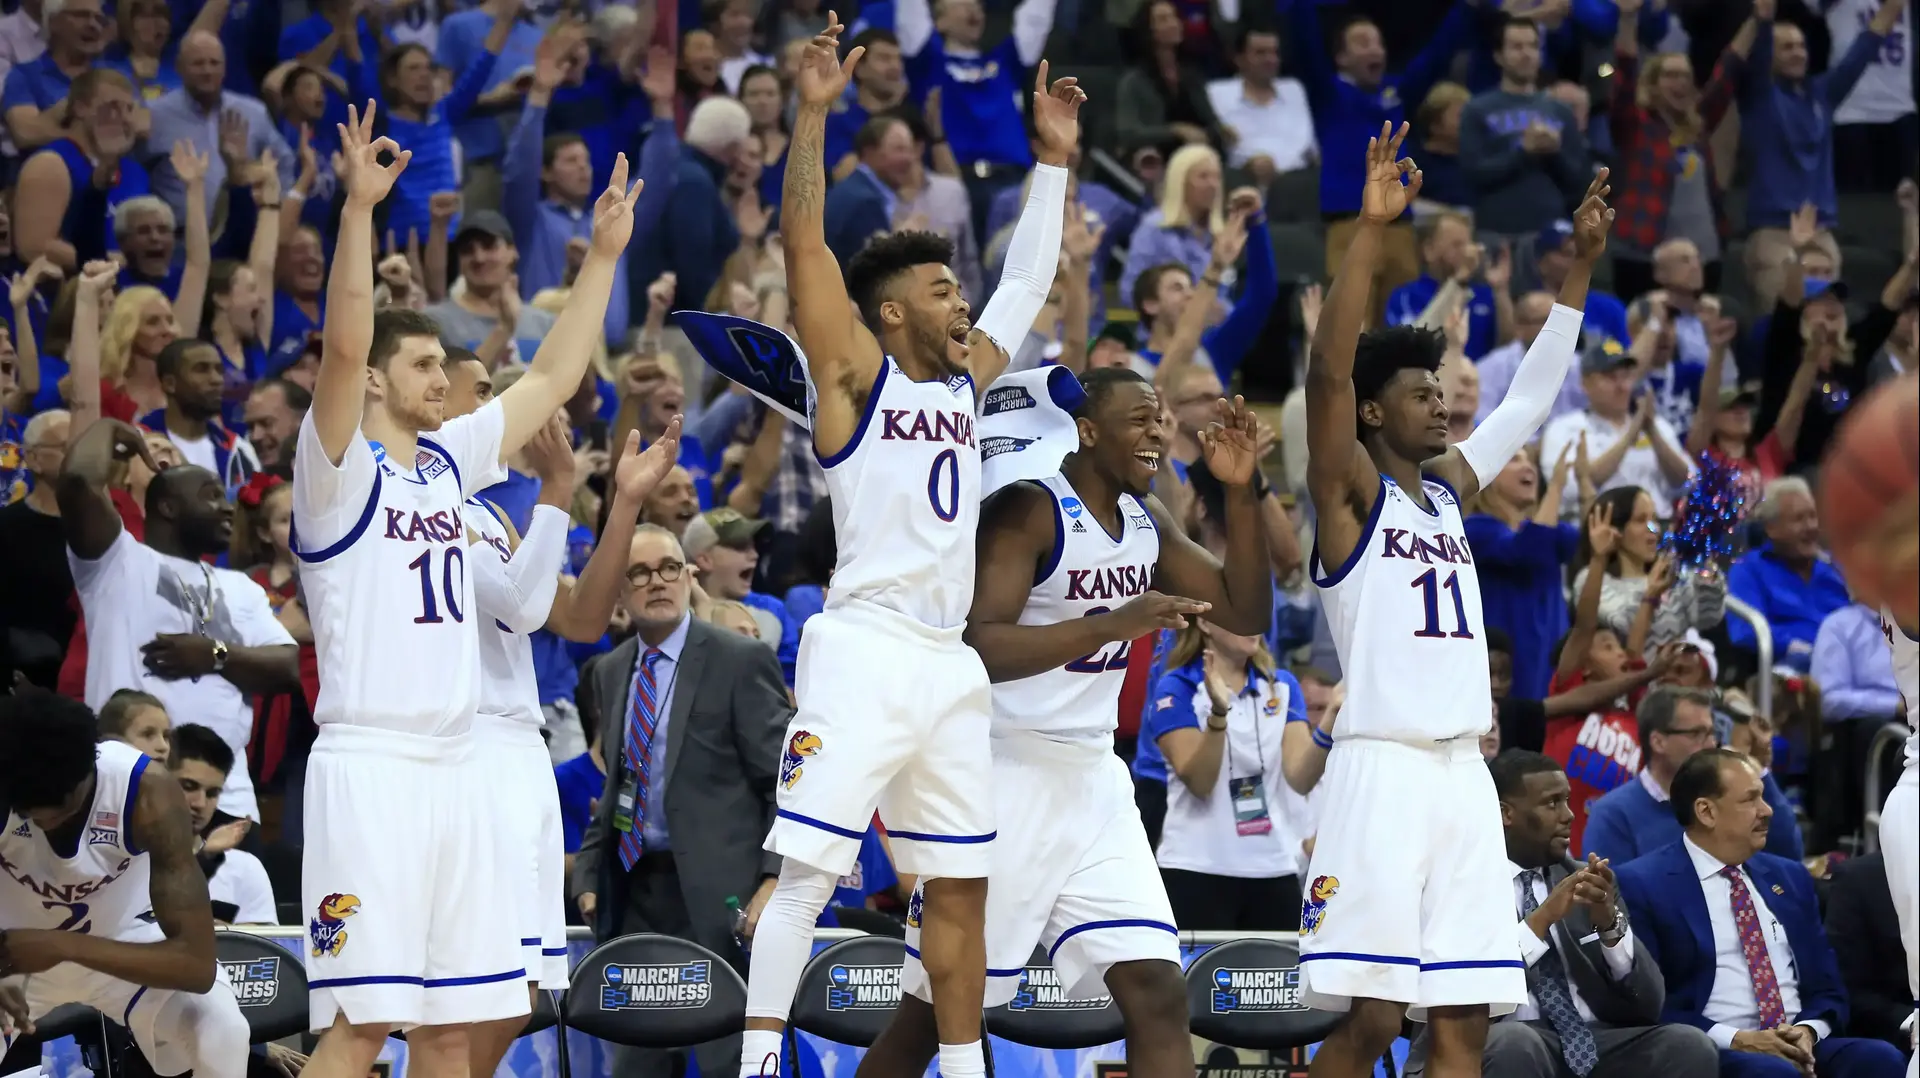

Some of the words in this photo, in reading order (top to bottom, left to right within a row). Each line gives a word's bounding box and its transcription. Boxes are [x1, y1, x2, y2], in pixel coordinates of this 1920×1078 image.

[986, 388, 1022, 405] MADNESS
[999, 397, 1027, 411] MARCH
[881, 409, 976, 450] KANSA
[980, 439, 1015, 452] MADNES
[986, 444, 1017, 458] MARCH
[928, 448, 960, 523] 0
[383, 505, 463, 544] KANSA
[1381, 528, 1472, 565] KANAS
[408, 546, 464, 624] 10
[1410, 567, 1474, 640] 11
[42, 900, 92, 934] 2
[623, 968, 679, 985] MARCH
[849, 968, 903, 985] MARCH
[1231, 971, 1285, 988] MARCH
[234, 981, 276, 999] NESS
[631, 983, 709, 1002] MADNESS
[857, 986, 903, 1002] MADN
[1240, 988, 1300, 1005] MADNES
